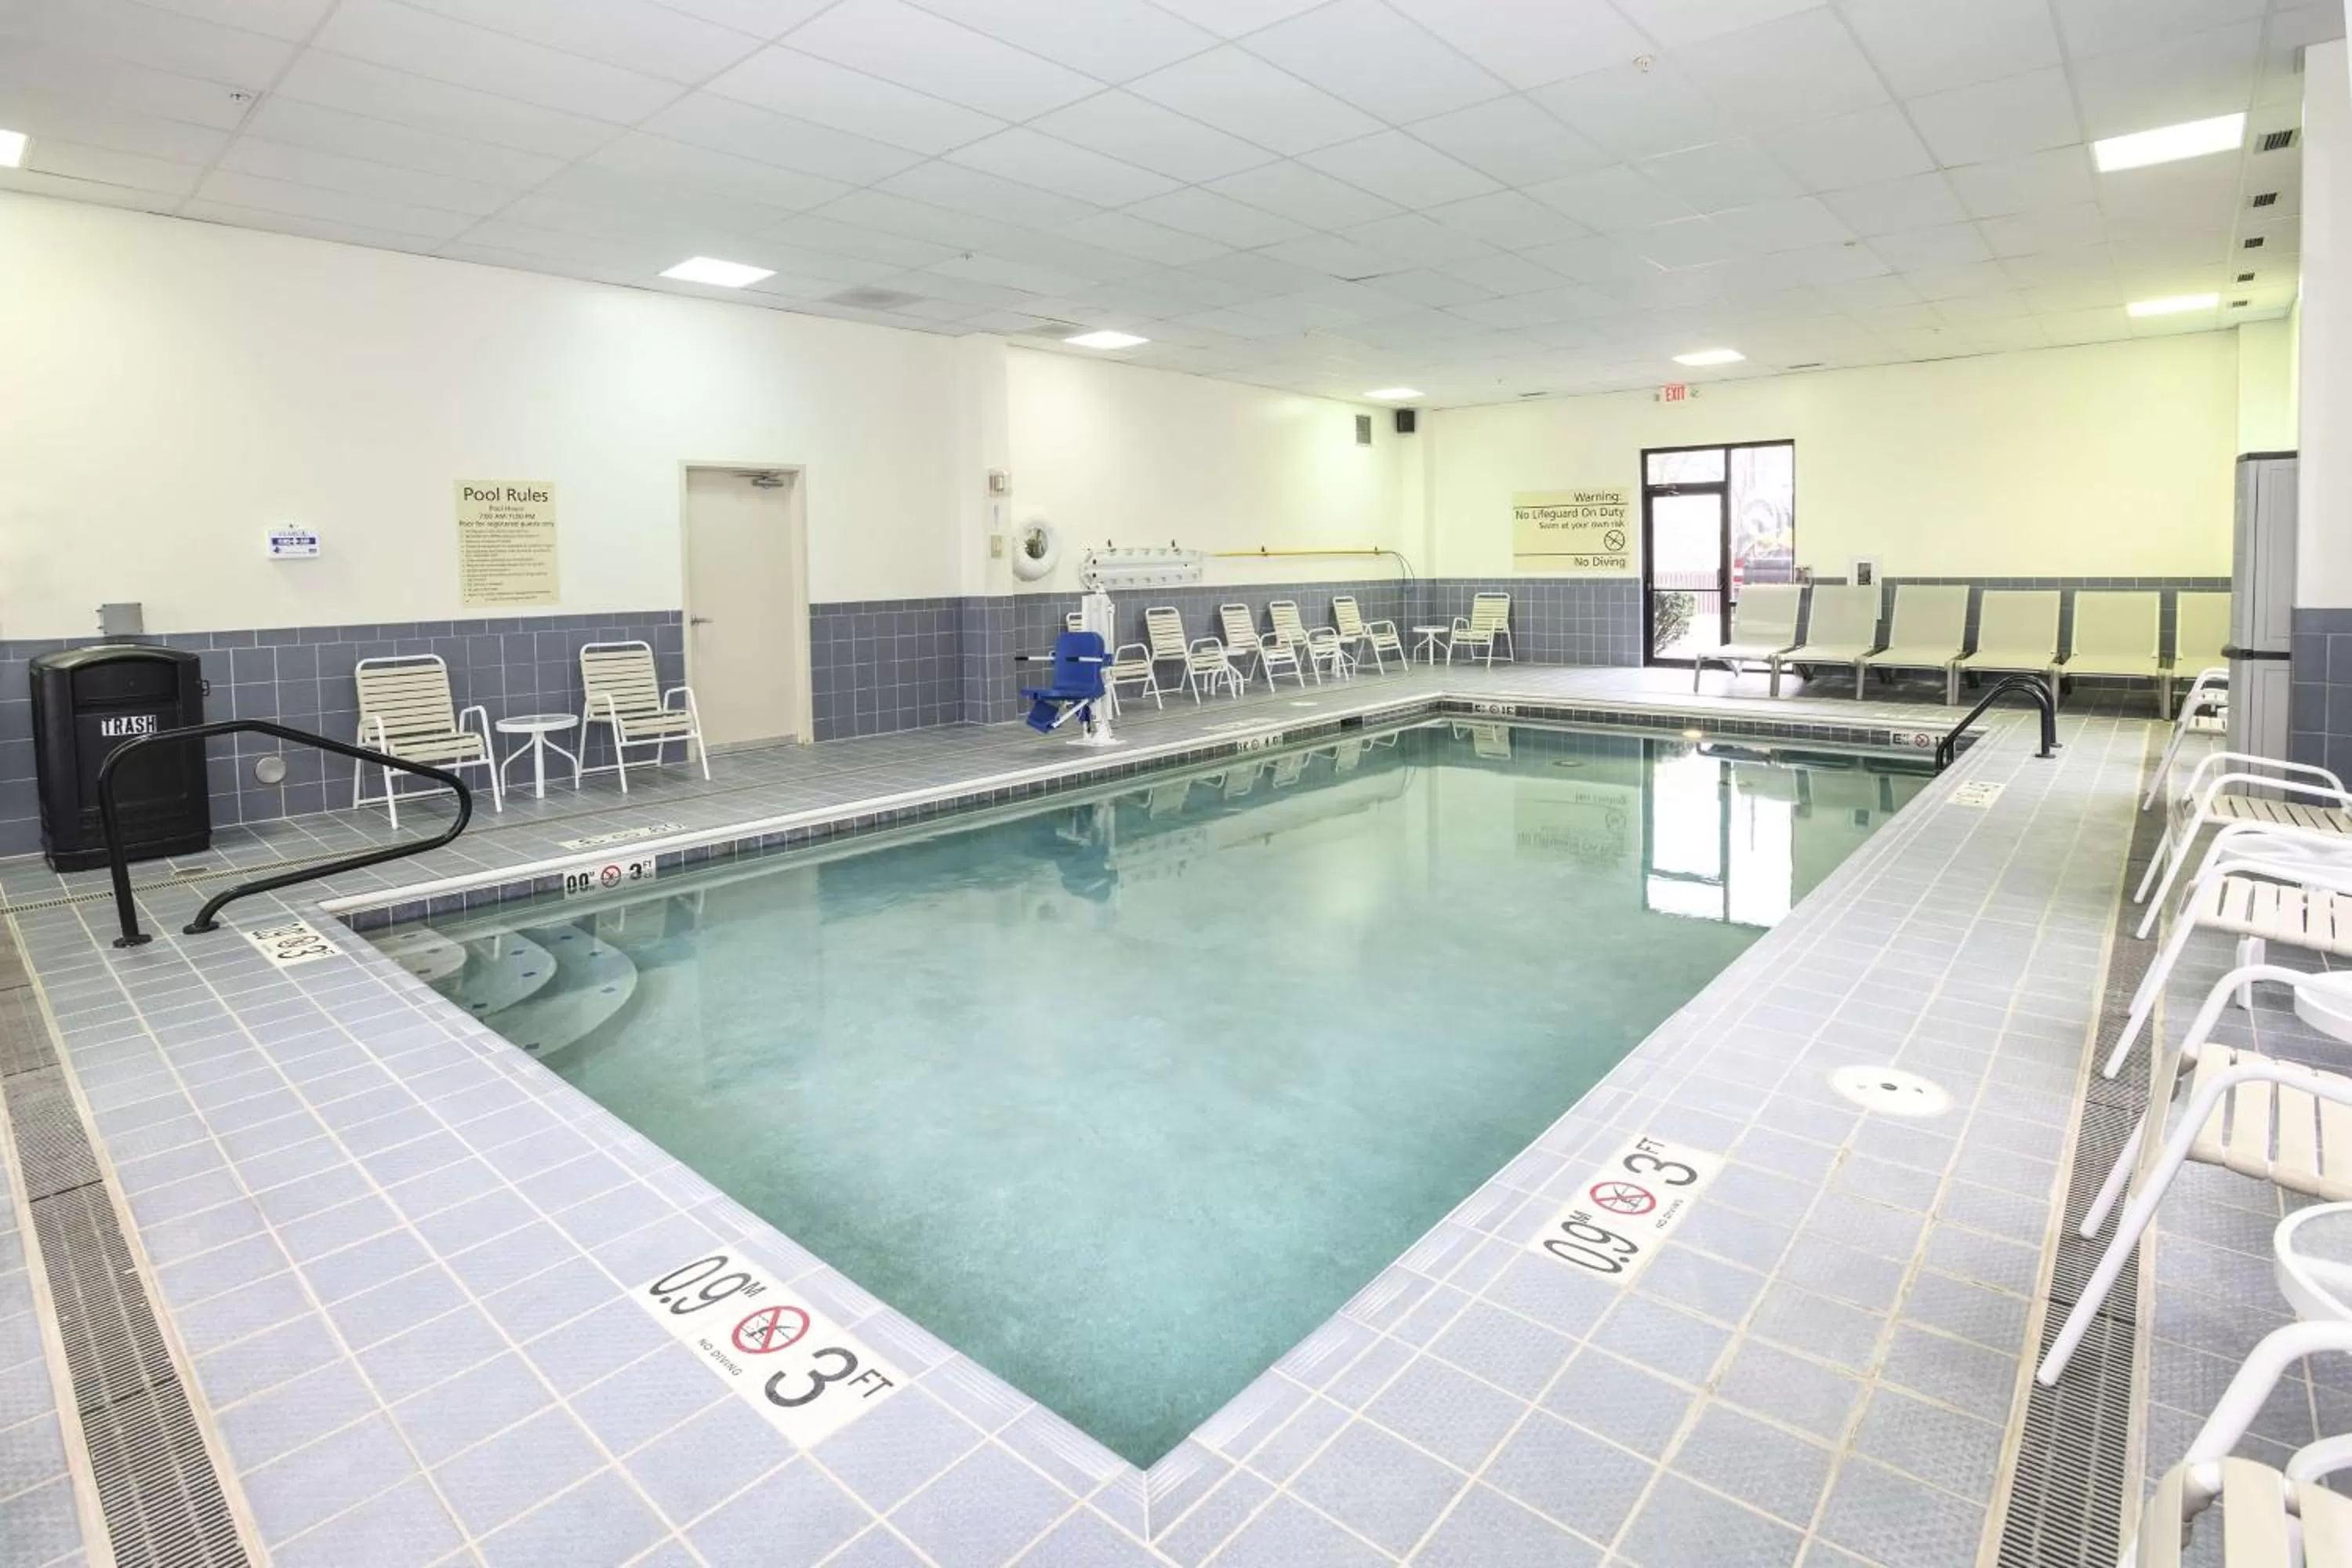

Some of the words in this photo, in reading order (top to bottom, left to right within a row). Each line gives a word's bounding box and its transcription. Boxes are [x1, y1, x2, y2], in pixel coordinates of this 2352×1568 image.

[1666, 385, 1685, 401] EXIT
[463, 487, 500, 501] Pool
[506, 488, 549, 502] Rules
[1515, 510, 1529, 520] No
[1533, 509, 1578, 521] Lifeguard
[1581, 508, 1596, 517] On
[1600, 507, 1625, 517] Duty
[1571, 521, 1589, 530] your
[1574, 557, 1589, 567] No
[1592, 557, 1626, 568] Diving
[103, 717, 154, 734] TRASH
[1635, 1137, 1665, 1155] FT
[1623, 1153, 1698, 1186] 3
[1543, 1221, 1639, 1273] 0.9
[649, 1255, 752, 1315] 0.9
[764, 1347, 858, 1407] 3
[848, 1368, 895, 1398] FT
[697, 1338, 713, 1352] NO
[710, 1349, 743, 1377] DIVING
